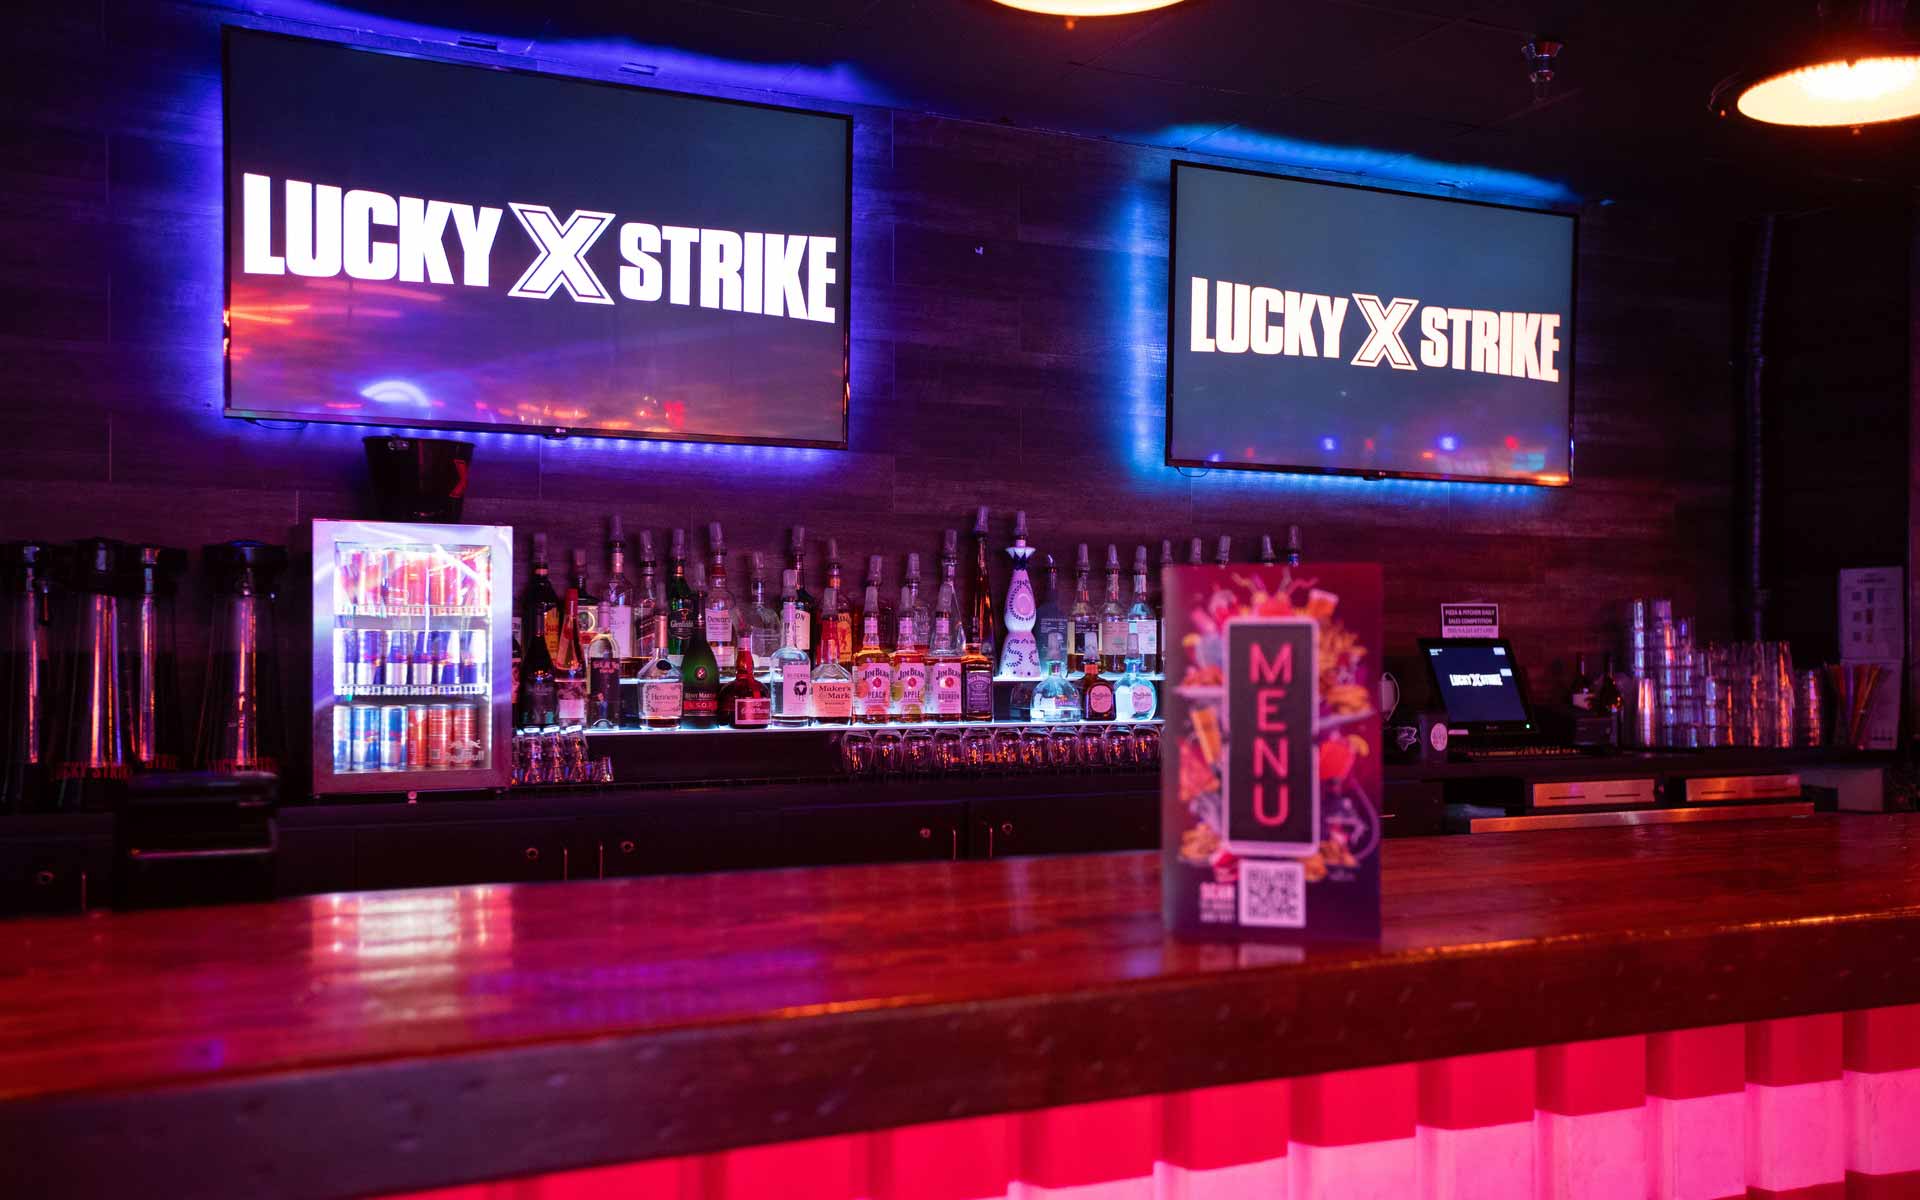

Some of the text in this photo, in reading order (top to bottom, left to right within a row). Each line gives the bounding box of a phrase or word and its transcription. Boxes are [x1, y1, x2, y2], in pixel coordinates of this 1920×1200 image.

[243, 172, 503, 287] LUCKY
[619, 222, 836, 323] STRIKE
[1190, 276, 1349, 359] LUCKY
[1420, 306, 1560, 383] STRIKE
[903, 690, 920, 698] APPLE
[1249, 642, 1292, 826] MENU
